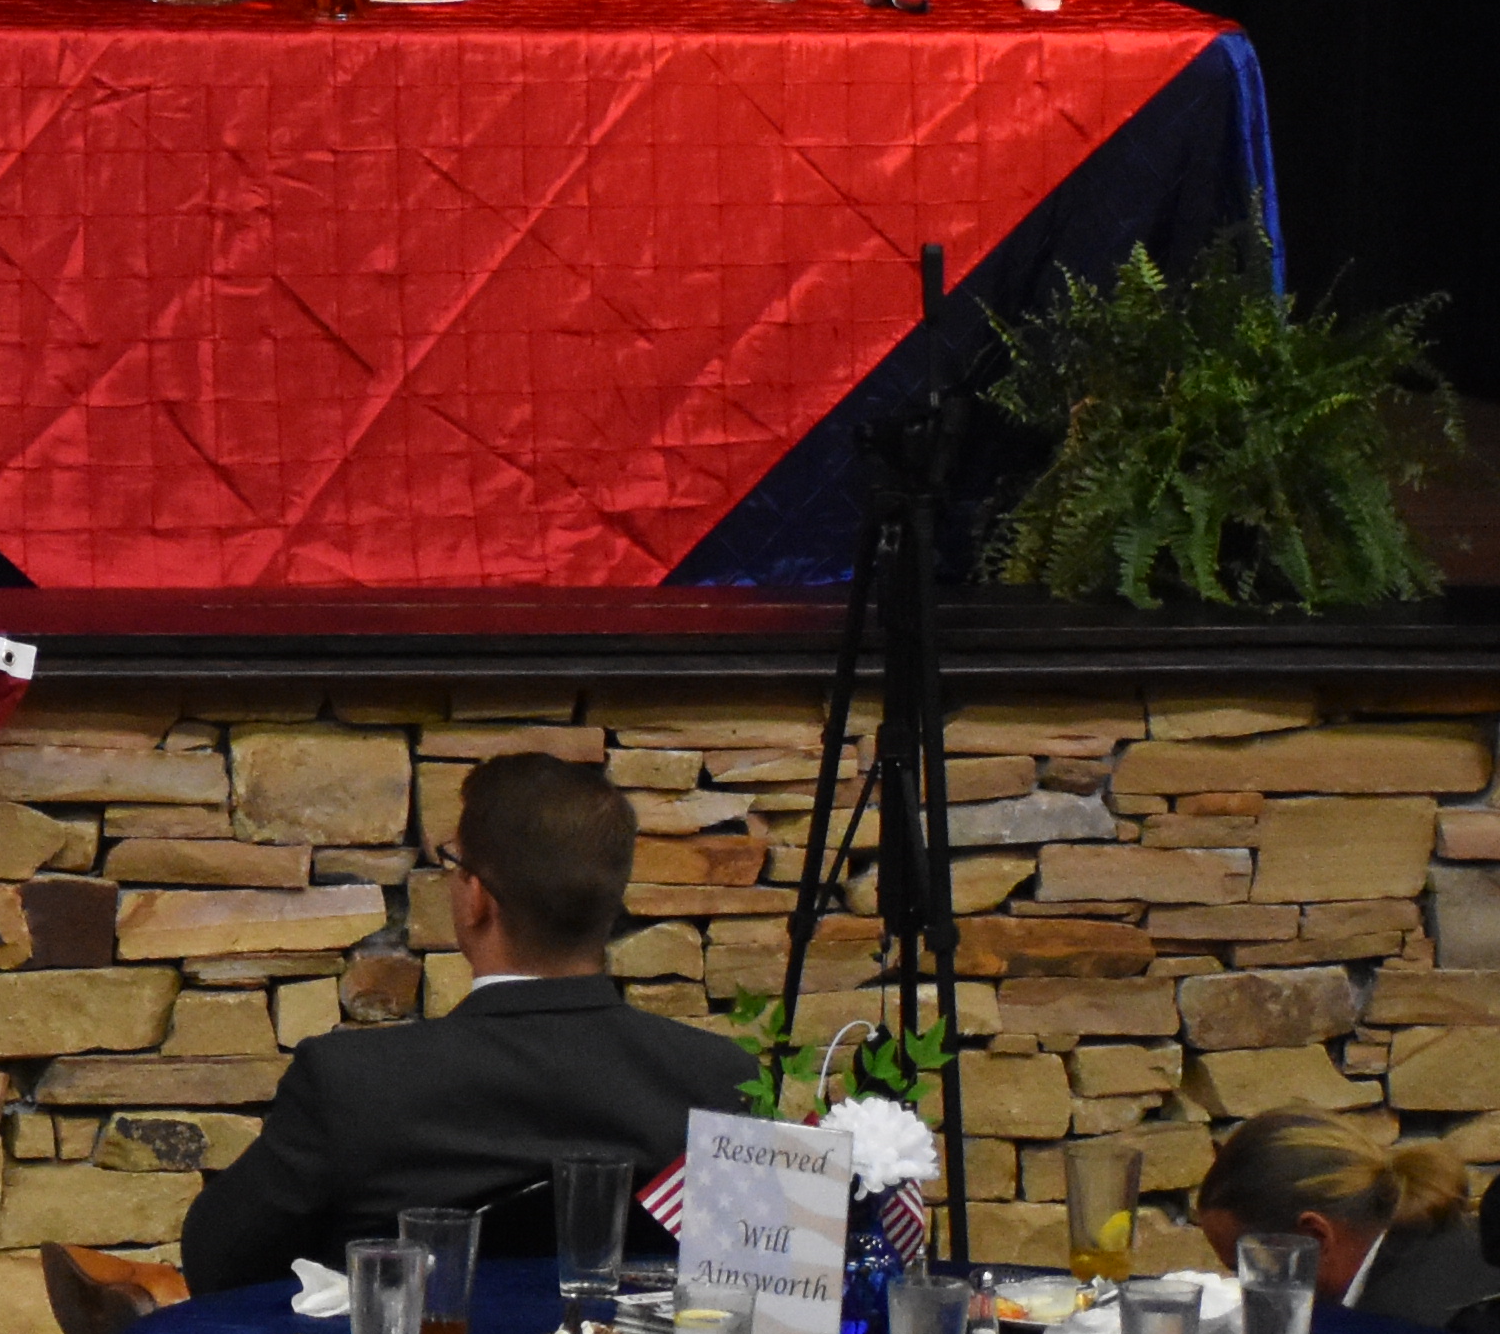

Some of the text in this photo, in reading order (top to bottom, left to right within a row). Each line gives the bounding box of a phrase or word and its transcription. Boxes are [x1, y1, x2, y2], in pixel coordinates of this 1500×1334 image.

[712, 1134, 834, 1176] Reserved
[737, 1218, 795, 1255] Will
[691, 1259, 828, 1302] Ainsworth
